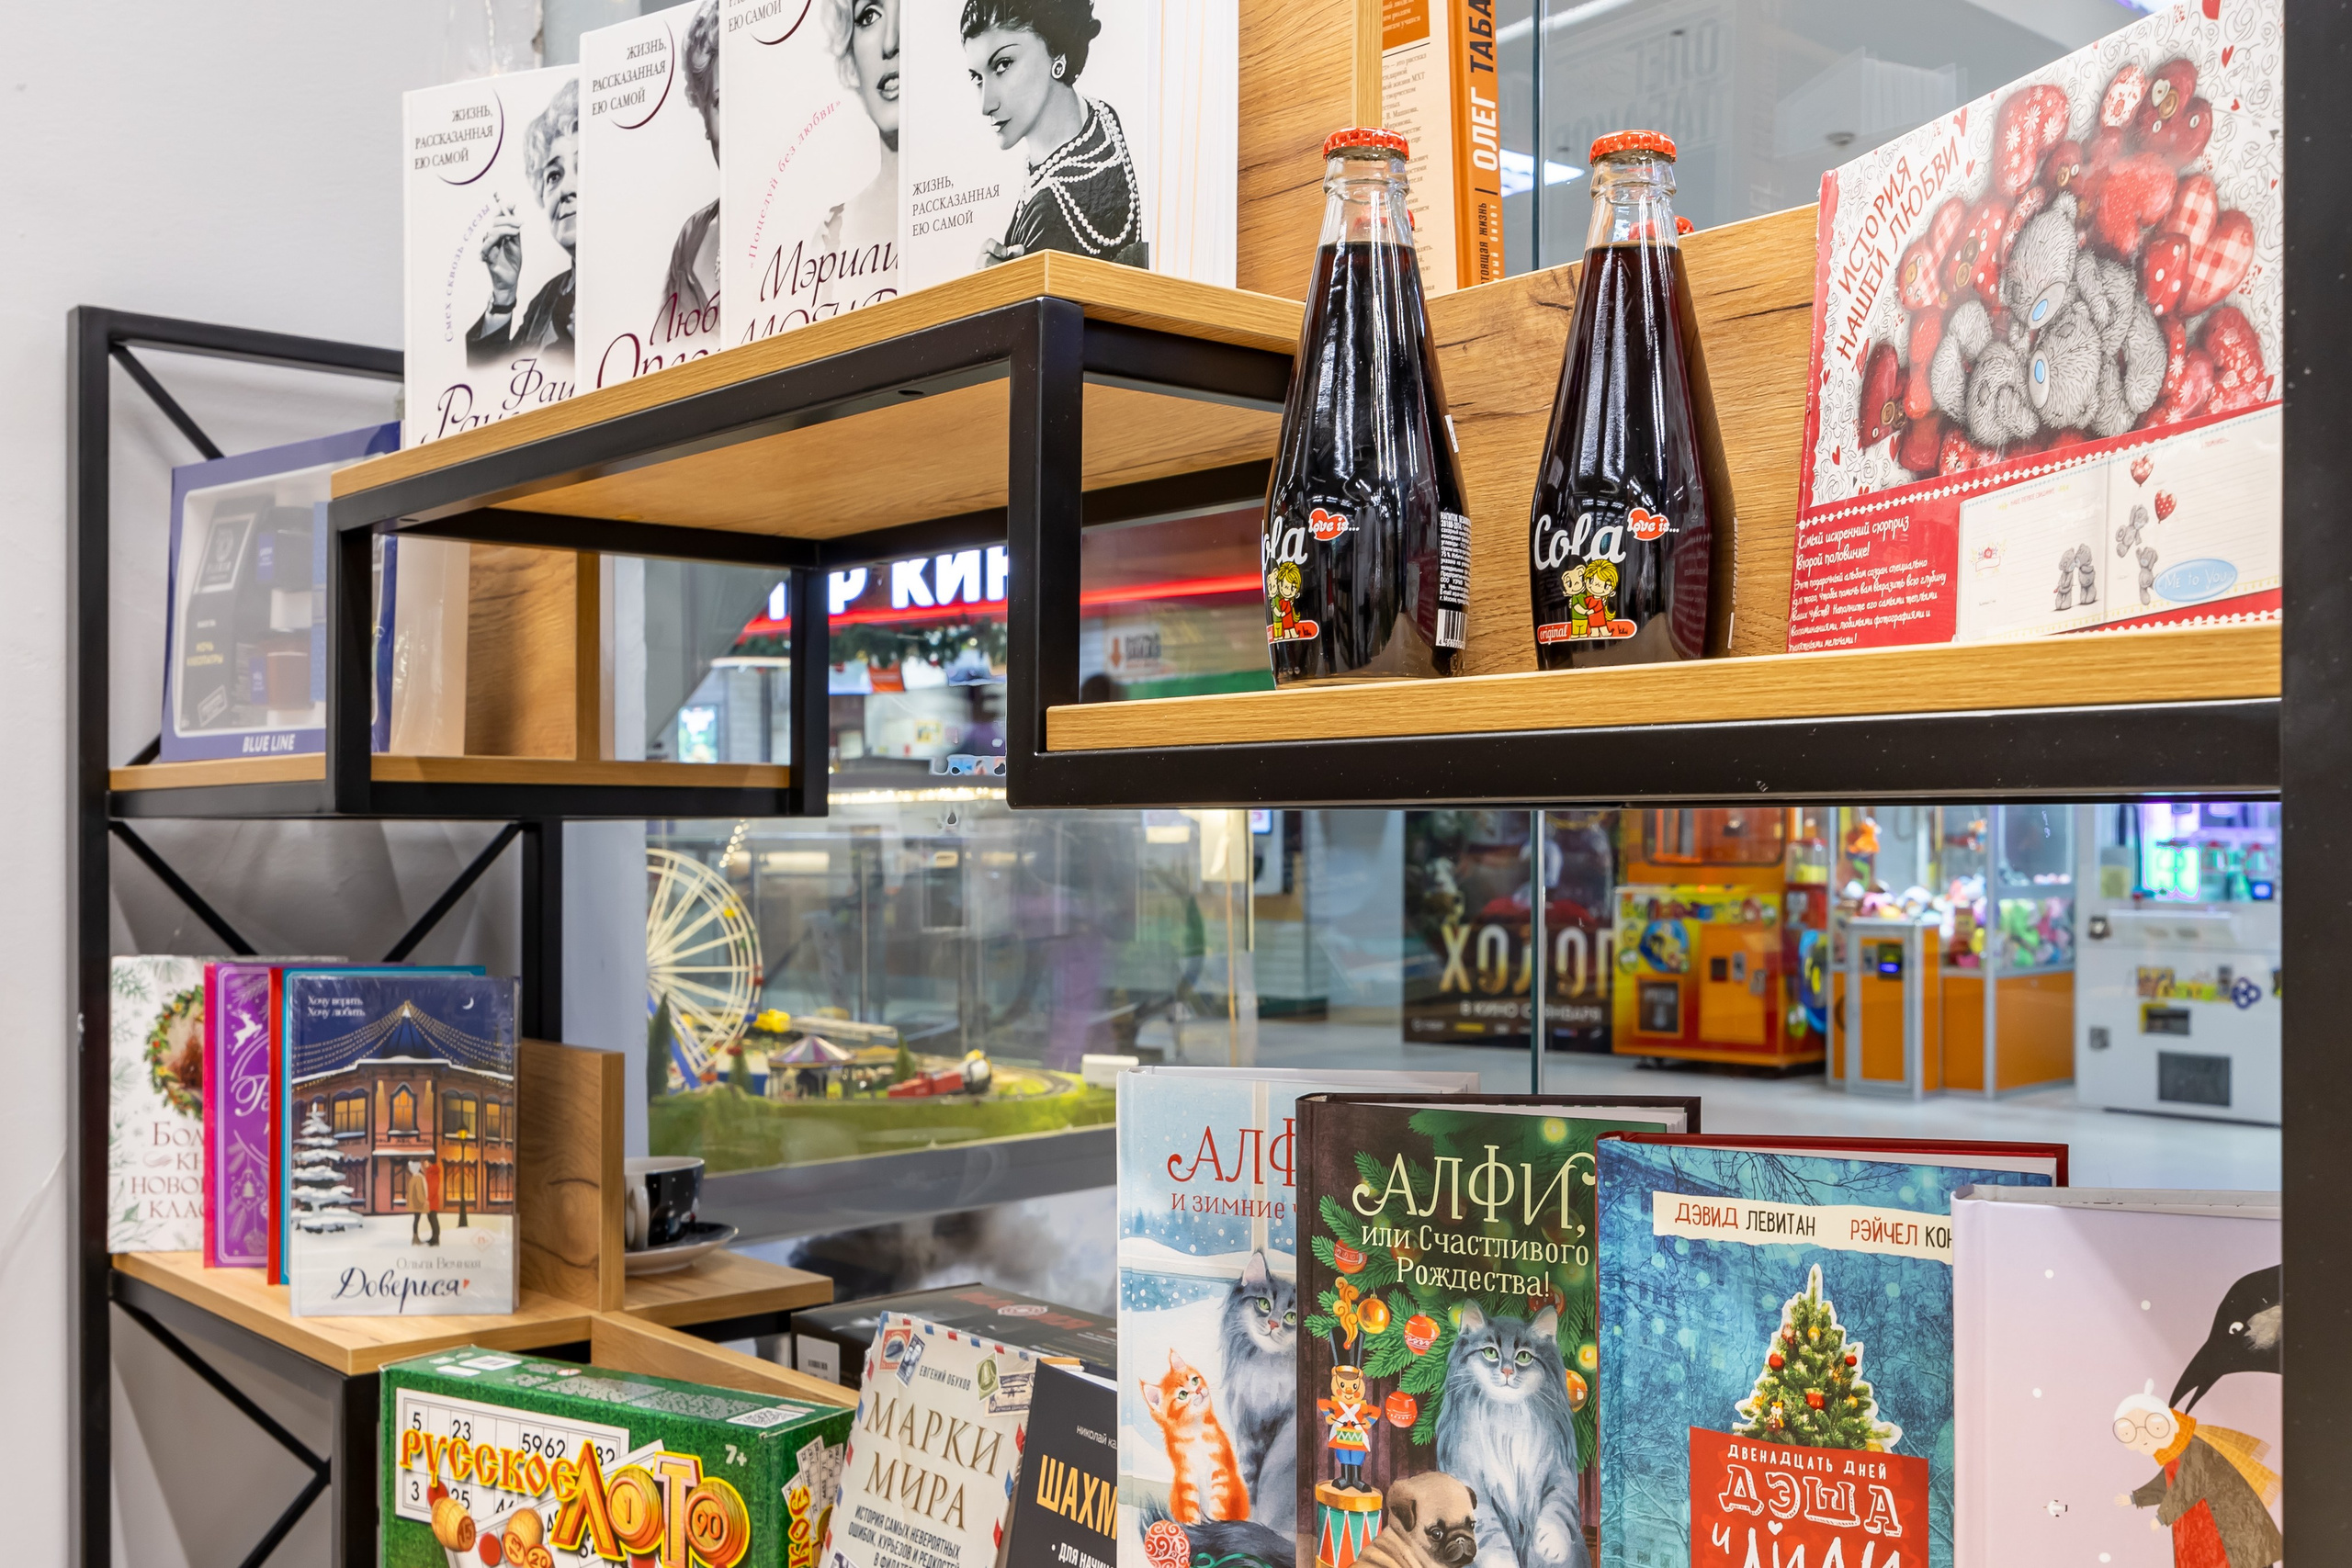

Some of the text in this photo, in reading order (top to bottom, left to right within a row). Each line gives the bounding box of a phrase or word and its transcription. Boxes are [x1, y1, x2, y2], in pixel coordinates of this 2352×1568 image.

[729, 14, 743, 33] ЕЮ
[627, 38, 667, 60] ЖИЗНЬ,
[592, 61, 666, 93] РАССКАЗАННАЯ
[592, 86, 646, 116] ЕЮ САМОЙ
[414, 125, 493, 150] РАССКАЗАННАЯ
[1471, 86, 1498, 172] ОЛЕГ
[414, 148, 469, 170] ЕЮ САМОЙ
[777, 145, 797, 174] без
[911, 175, 954, 197] ЖИЗНЬ,
[911, 184, 1001, 217] РАССКАЗАННАЯ
[911, 209, 974, 237] ЕЮ САМОЙ
[1838, 154, 1913, 295] ИСТОРИЯ
[1837, 135, 1960, 362] НАШЕЙ ЛЮБВИ
[1308, 517, 1335, 534] love
[1626, 517, 1680, 533] love is...
[1826, 522, 1871, 551] искренний
[1871, 515, 1910, 542] сюрприз
[1533, 513, 1627, 571] Cola
[1844, 566, 1867, 581] альбом
[1867, 566, 1889, 581] создан
[1888, 558, 1928, 577] специально
[1860, 580, 1873, 594] вам
[1905, 573, 1920, 587] всю
[1919, 570, 1948, 589] глубину
[2188, 570, 2200, 587] to
[1832, 602, 1866, 615] Наполните
[1866, 599, 1879, 611] его
[1878, 596, 1905, 609] самыми
[1539, 624, 1568, 645] original
[1838, 615, 1874, 631] любимыми
[1873, 610, 1926, 630] фотографиями
[1926, 610, 1931, 618] и
[243, 733, 296, 753] BLUE LINE
[308, 995, 331, 1009] Хочу
[308, 1007, 331, 1020] Хочу
[1351, 1145, 1596, 1239] АЛФИ,
[1674, 1201, 1739, 1230] ДЭВИД
[1746, 1210, 1816, 1237] ЛЕВИТАН
[1849, 1217, 1918, 1247] РЭЙЧЕЛ
[1419, 1224, 1590, 1268] Счастливого
[396, 1257, 481, 1270] Ольга Вечная
[1396, 1256, 1550, 1299] Рождества!
[331, 1267, 461, 1314] Доверься
[919, 1364, 971, 1393] ЕВГЕНИЙ ОБУХОВ
[521, 1432, 543, 1454] 59
[863, 1390, 1006, 1480] МАРКИ
[725, 1443, 748, 1467] 7+
[1727, 1444, 1887, 1481] ДВЕНАДЦАТЬ ДНЕЙ
[411, 1481, 421, 1502] 3
[862, 1450, 968, 1534] МИРА
[1718, 1463, 1904, 1538] ДЭША
[848, 1521, 877, 1549] ОШИБОК,
[877, 1533, 912, 1561] КУРЬЕЗОВ
[912, 1551, 920, 1562] И
[854, 1504, 962, 1561] ИСТОРИЯ САМЫХ НЕВЕРОЯТНЫХ
[1057, 1541, 1080, 1566] ДЛЯ
